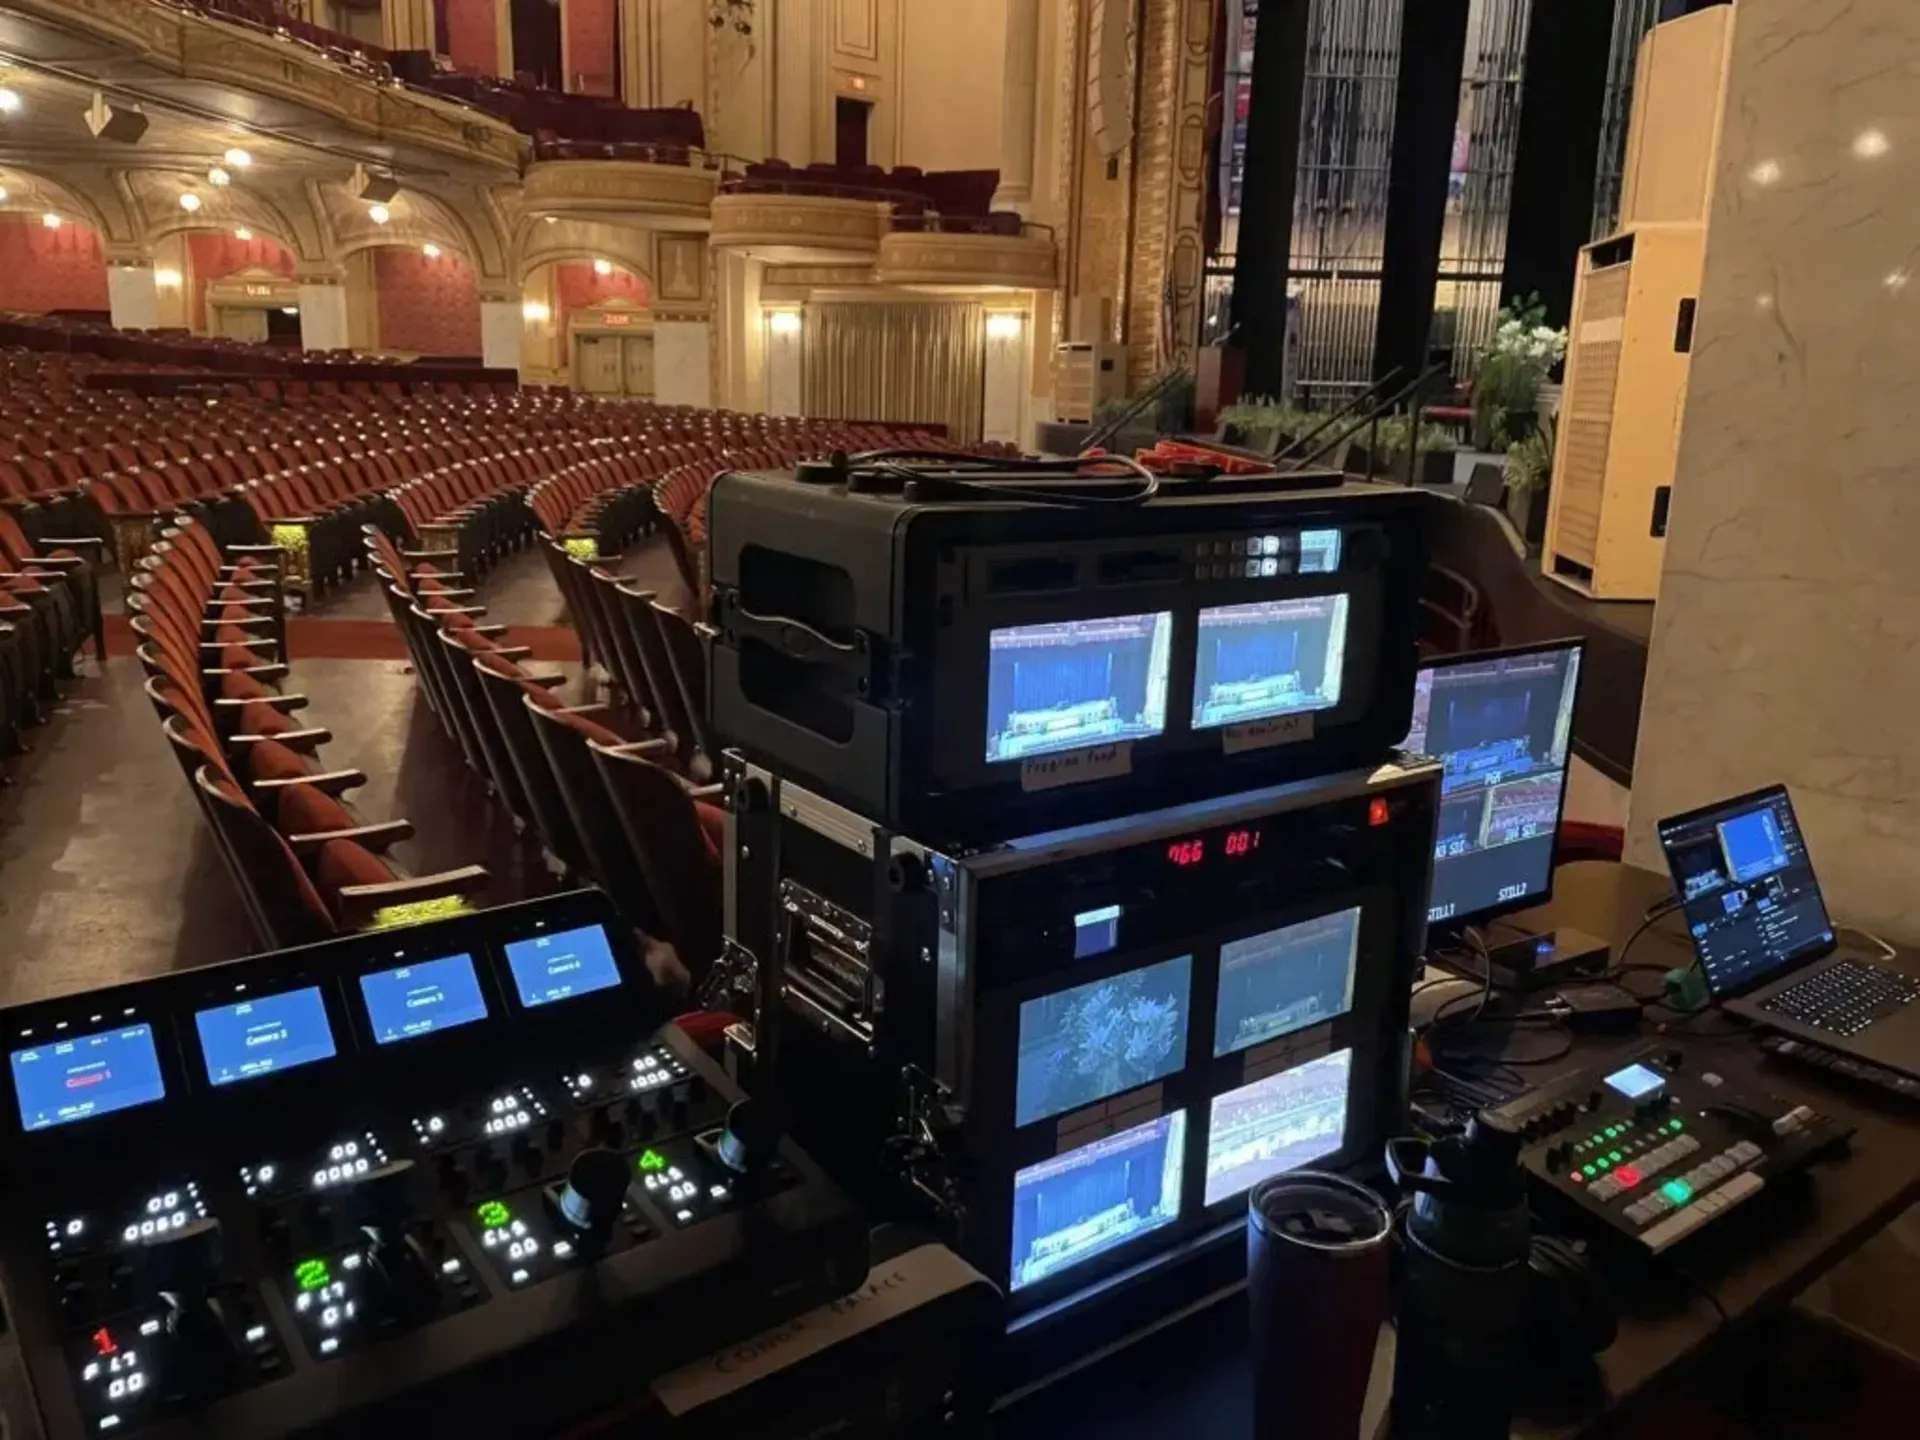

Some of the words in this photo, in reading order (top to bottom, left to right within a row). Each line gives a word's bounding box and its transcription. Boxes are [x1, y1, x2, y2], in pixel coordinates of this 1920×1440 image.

[640, 1150, 664, 1169] 4
[478, 1202, 509, 1225] 3
[295, 1260, 329, 1289] 2
[93, 1328, 118, 1355] 1
